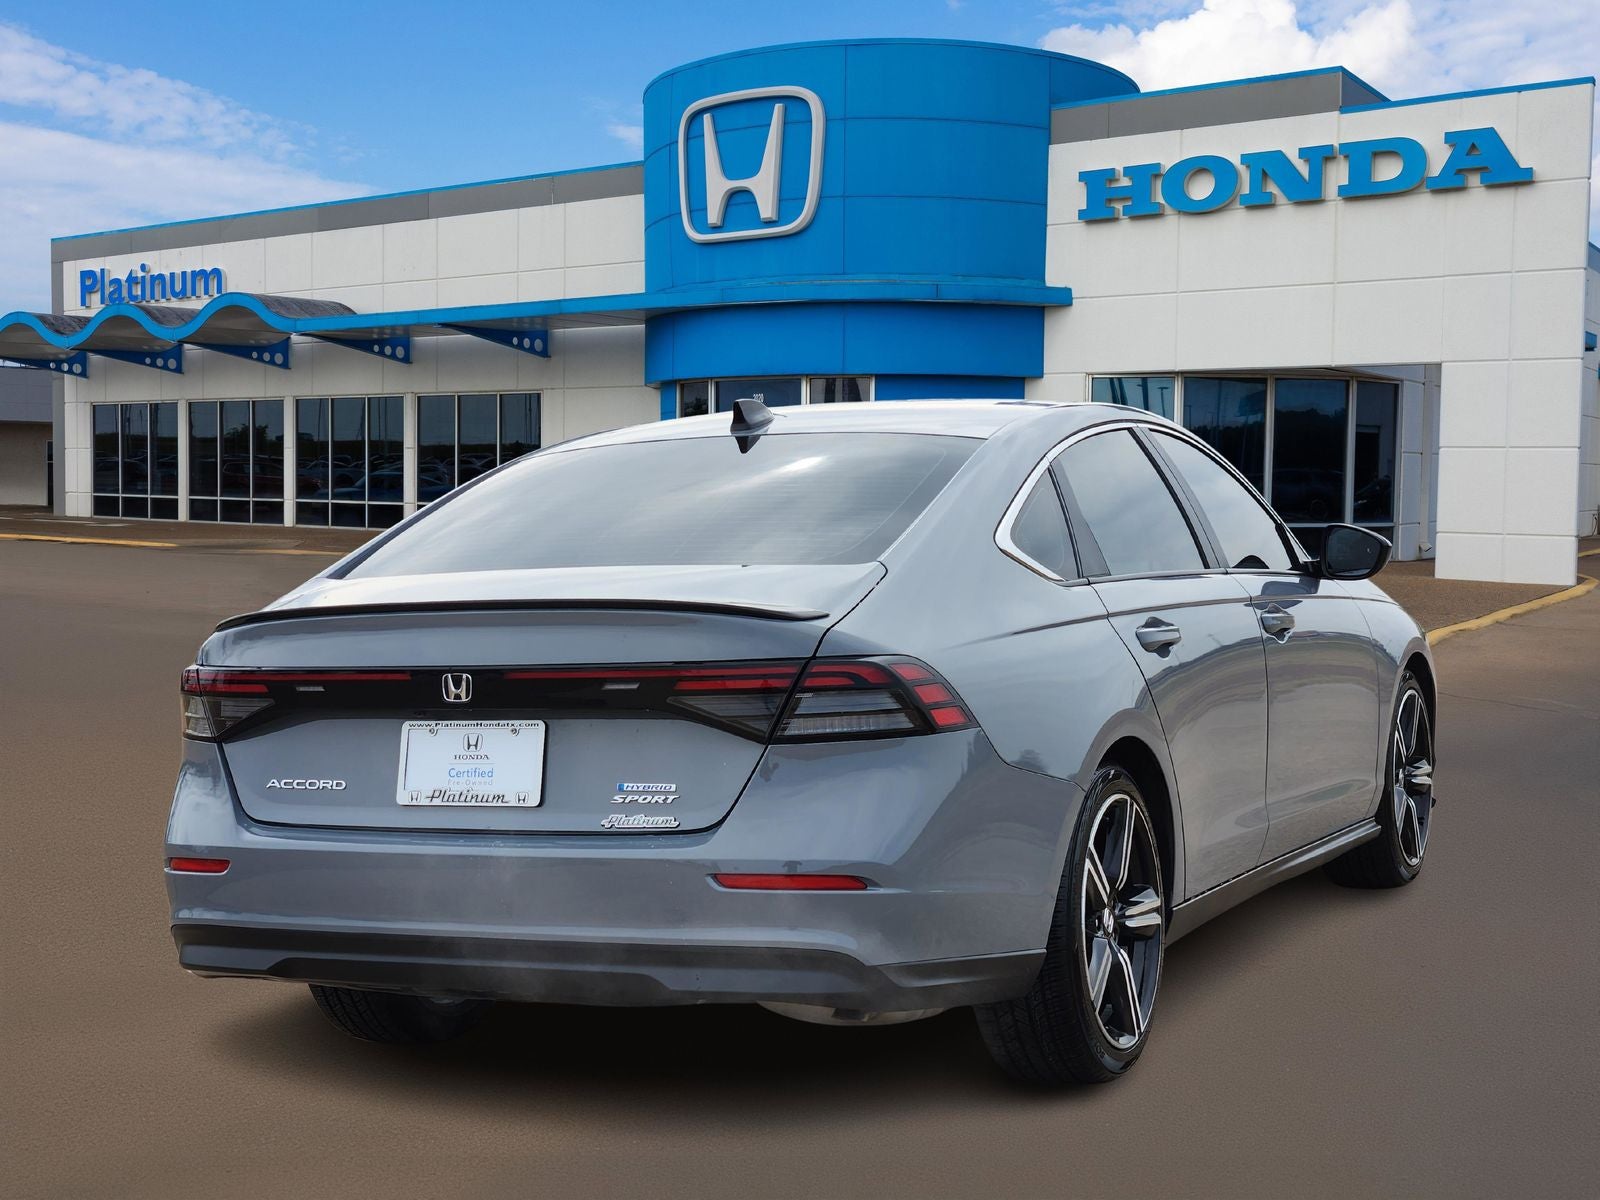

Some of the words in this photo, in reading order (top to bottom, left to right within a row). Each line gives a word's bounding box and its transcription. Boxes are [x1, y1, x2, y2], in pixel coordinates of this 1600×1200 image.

[1078, 127, 1534, 221] HONDA
[80, 263, 224, 307] Platinum
[448, 767, 494, 778] Certified
[266, 779, 346, 790] ACCORD
[425, 787, 511, 804] Platinum
[610, 795, 679, 804] SPORT
[600, 814, 680, 829] Platinum
